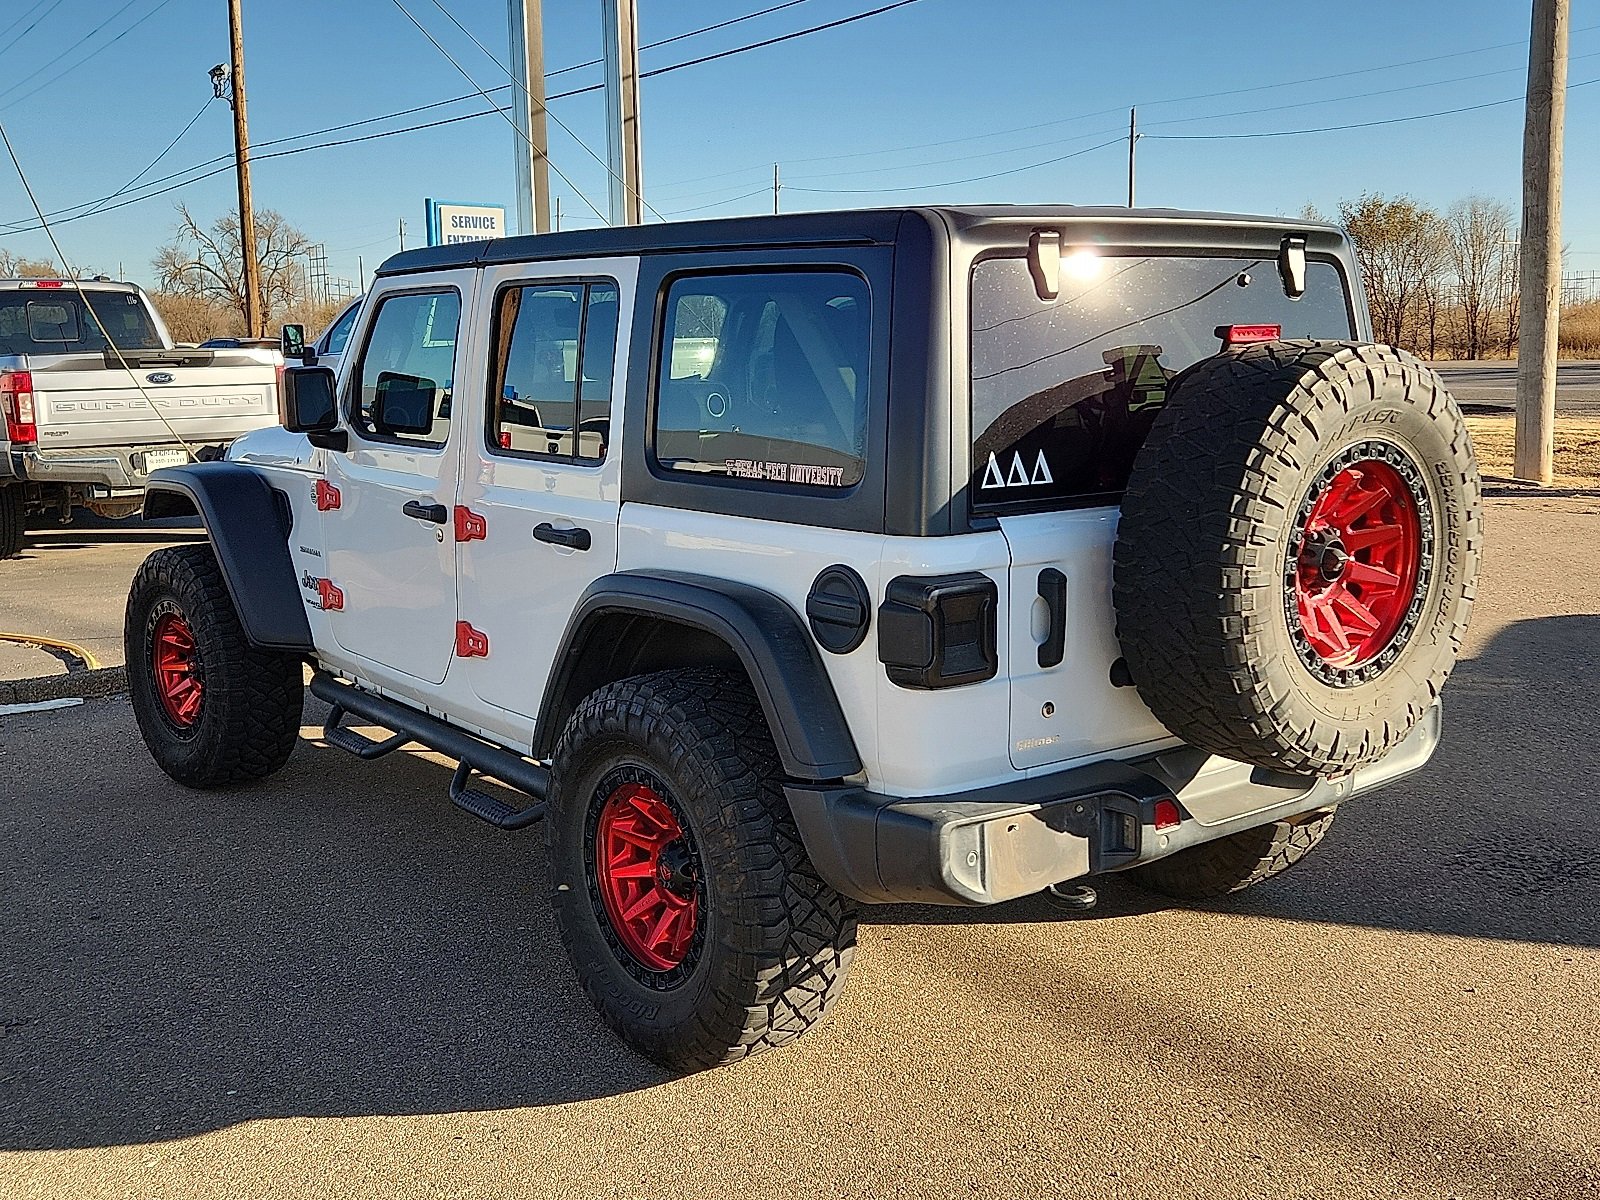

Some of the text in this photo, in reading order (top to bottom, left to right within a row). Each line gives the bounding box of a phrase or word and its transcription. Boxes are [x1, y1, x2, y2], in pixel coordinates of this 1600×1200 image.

[451, 215, 496, 230] SERVICE
[55, 396, 260, 412] SUPER DUTY
[735, 460, 763, 479] TEXAS
[765, 462, 788, 482] TECH
[789, 464, 844, 487] UNIVERSITY
